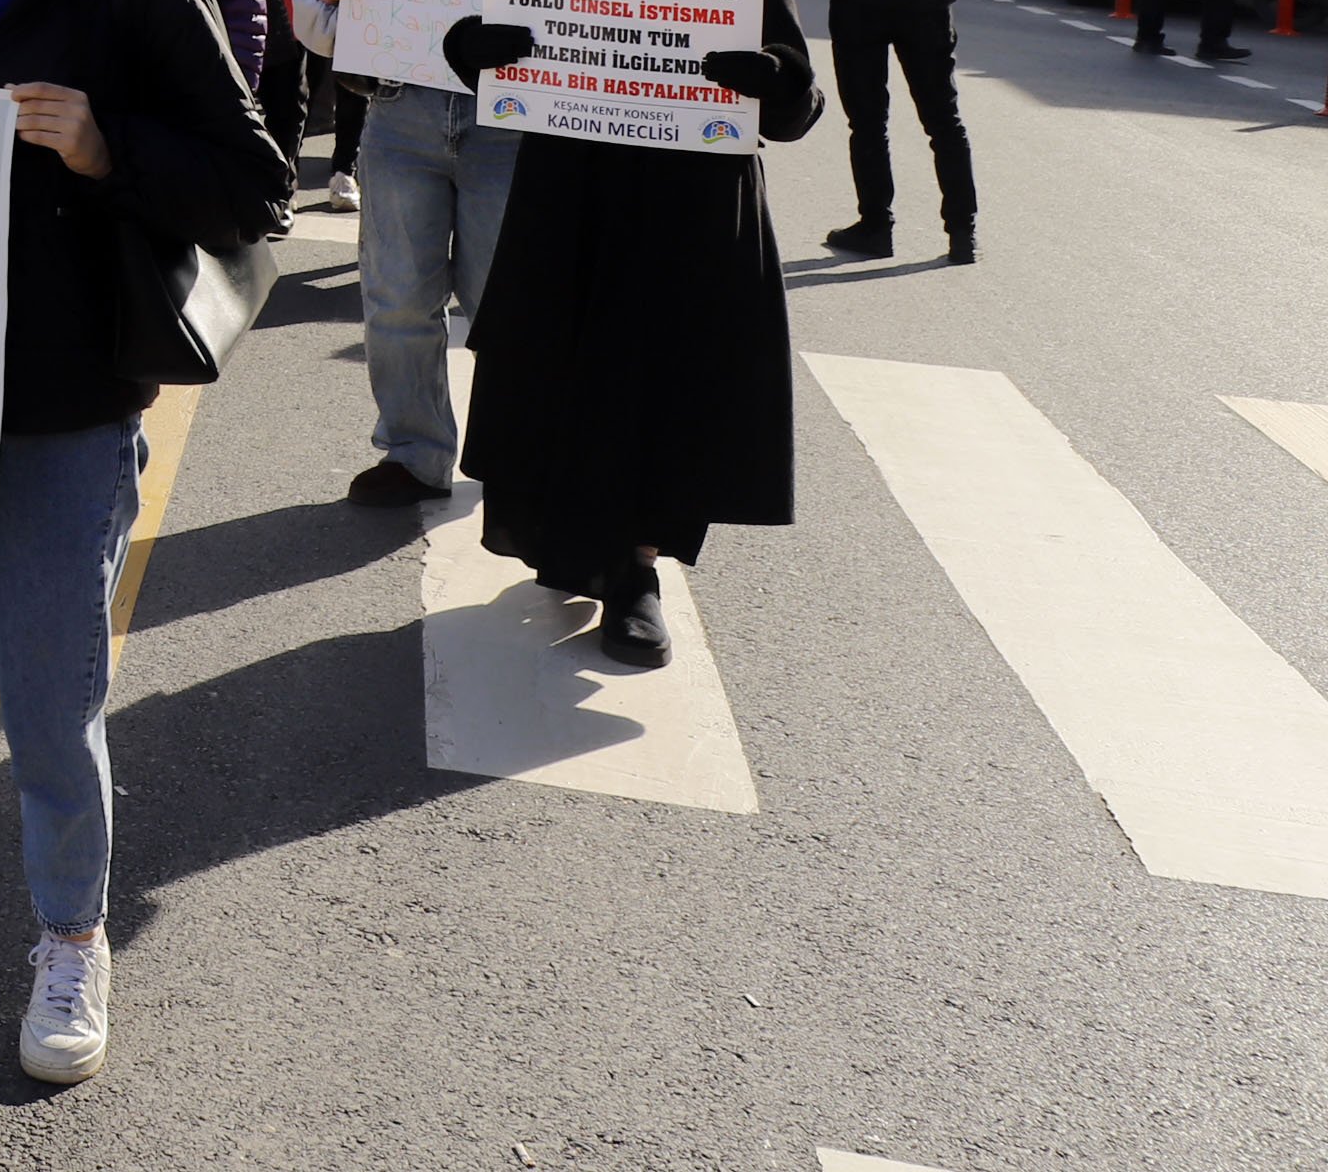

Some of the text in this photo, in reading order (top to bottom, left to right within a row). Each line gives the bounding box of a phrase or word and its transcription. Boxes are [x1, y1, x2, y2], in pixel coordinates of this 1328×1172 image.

[639, 1, 736, 26] İSTİSMAR
[544, 19, 691, 49] TOPLUMUN TÜM
[495, 66, 741, 105] SOSYAL BİR HASTALIKTIR!
[553, 100, 675, 123] KEŞAN KENT KONSEYİ
[547, 113, 680, 143] KADIN MECLİSİ
